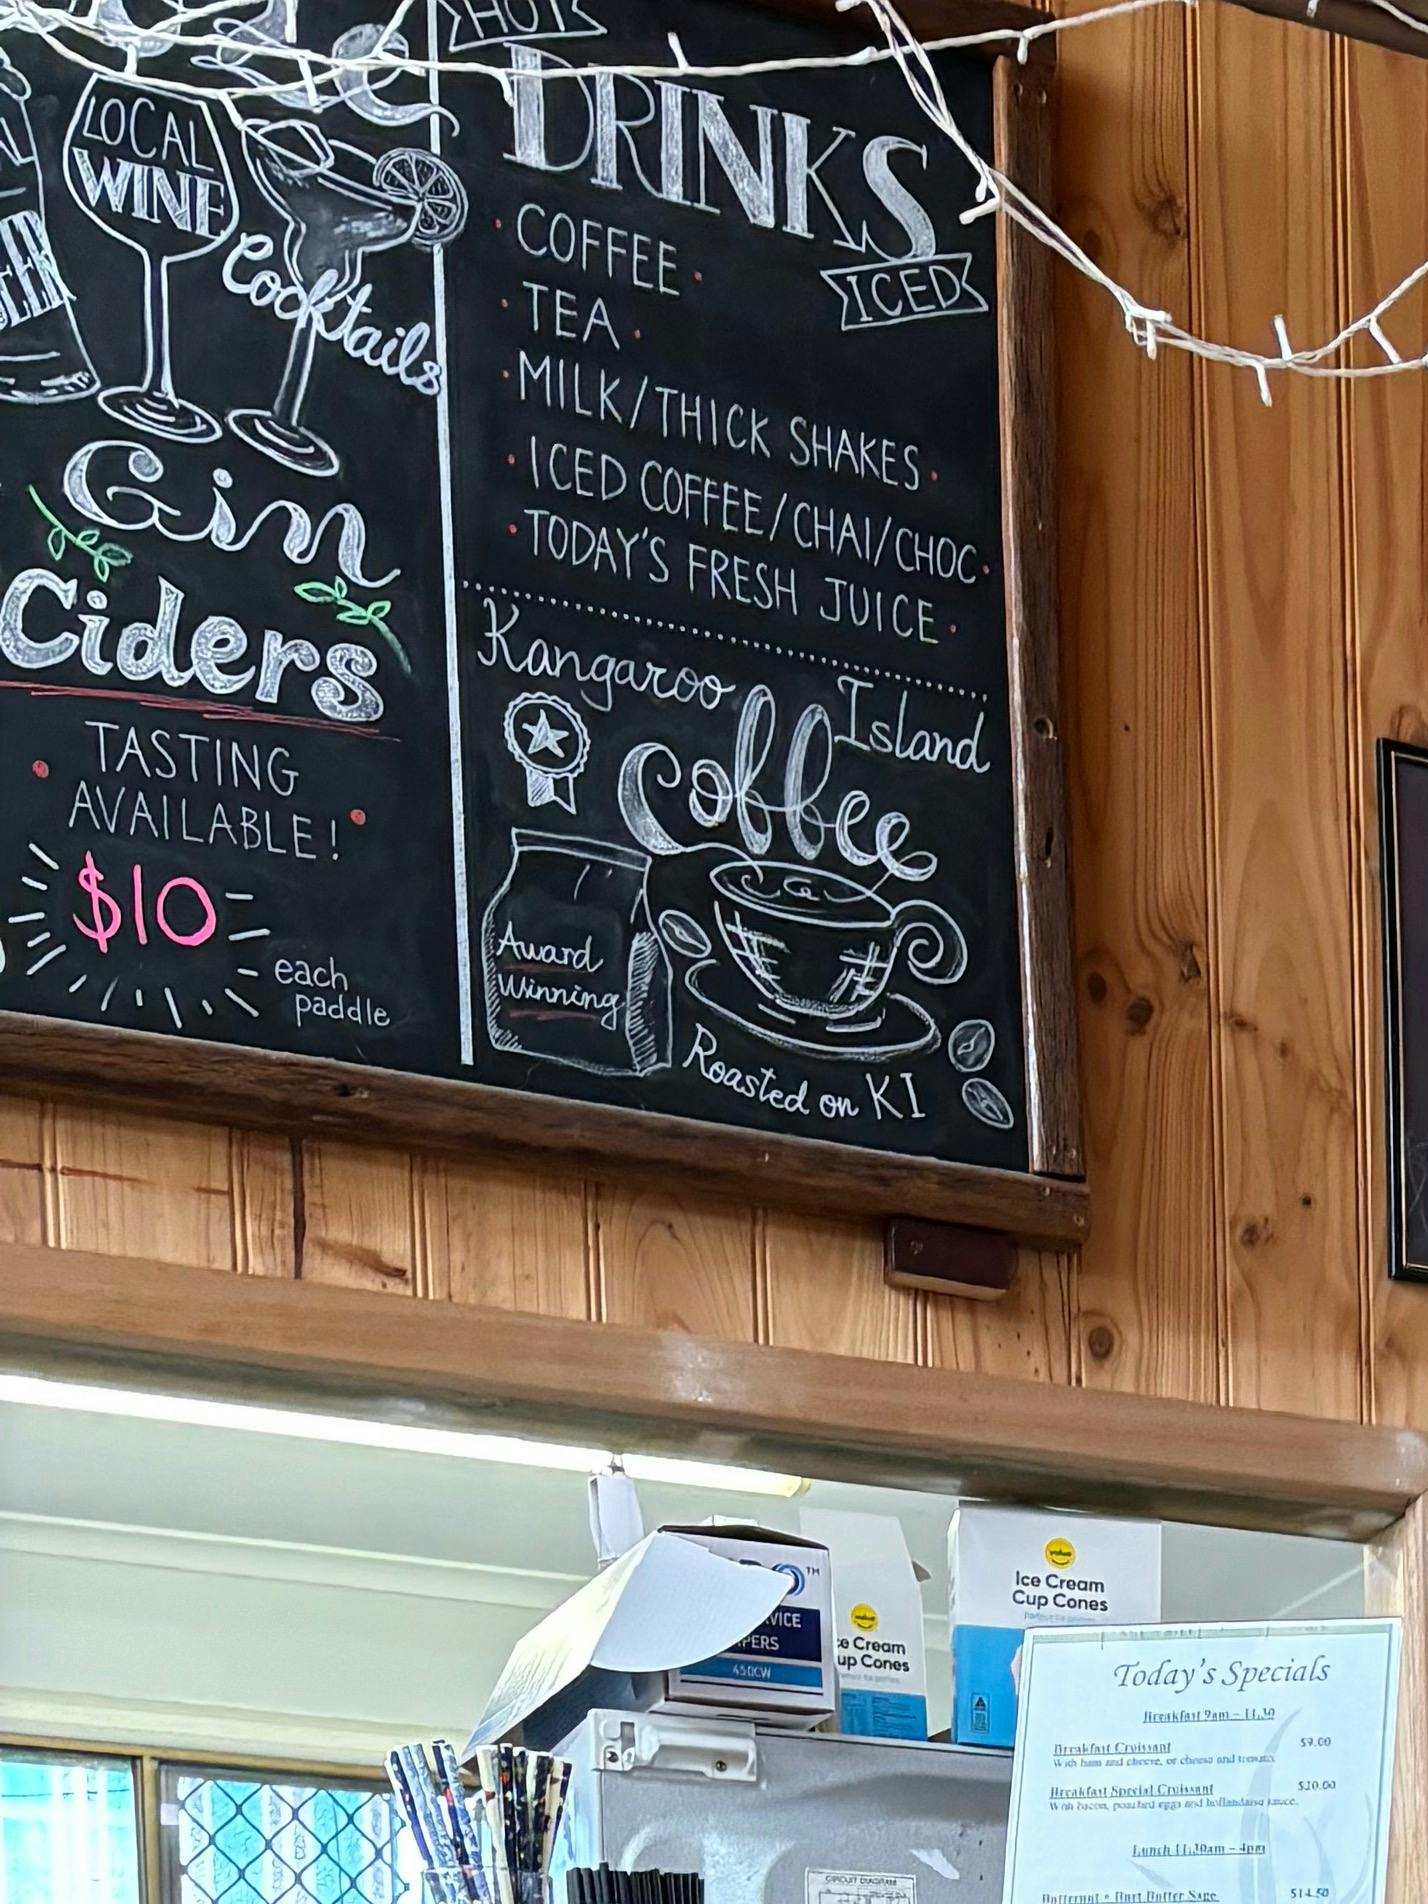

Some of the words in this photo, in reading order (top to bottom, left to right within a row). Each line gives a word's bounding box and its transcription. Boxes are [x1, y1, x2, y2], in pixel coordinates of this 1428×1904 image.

[82, 98, 214, 172] LOCAL
[502, 41, 937, 262] DRINKS
[72, 148, 226, 241] WINE
[516, 203, 680, 297] COFFEE
[221, 232, 443, 396] Cocktails
[522, 280, 621, 349] TEA
[844, 265, 962, 323] ICED
[518, 350, 771, 460] MILK/THICK
[788, 415, 921, 492] SHAKES
[62, 438, 401, 589] Gin
[530, 435, 628, 501] ICED
[639, 458, 978, 585] COFFEE/CHAI/CHOC
[523, 507, 671, 584] TODAY'S
[687, 541, 799, 616] FRESH
[818, 576, 940, 645] JUICE
[1, 566, 386, 722] Ciders
[477, 597, 738, 713] Kangaroo
[833, 676, 991, 774] Island
[84, 719, 300, 797] TASTING
[618, 682, 938, 882] Coffee
[72, 850, 218, 953] $10
[274, 956, 349, 991] each
[496, 936, 604, 976] Award
[294, 993, 391, 1027] paddle
[497, 972, 626, 1030] Winning
[682, 1022, 812, 1118] Roasted
[818, 1093, 860, 1119] on
[865, 1070, 926, 1121] KI
[1012, 1589, 1049, 1611] Cup
[1052, 1592, 1109, 1612] Cones
[1015, 1570, 1042, 1588] Ice
[1045, 1573, 1105, 1594] Cream
[837, 1655, 858, 1670] up
[859, 1654, 911, 1673] Cones
[852, 1636, 907, 1656] Cream
[1113, 1657, 1218, 1695] Today's
[1221, 1653, 1332, 1693] Specials
[1143, 1708, 1200, 1723] Breakfast
[1132, 1844, 1171, 1857] Lunch
